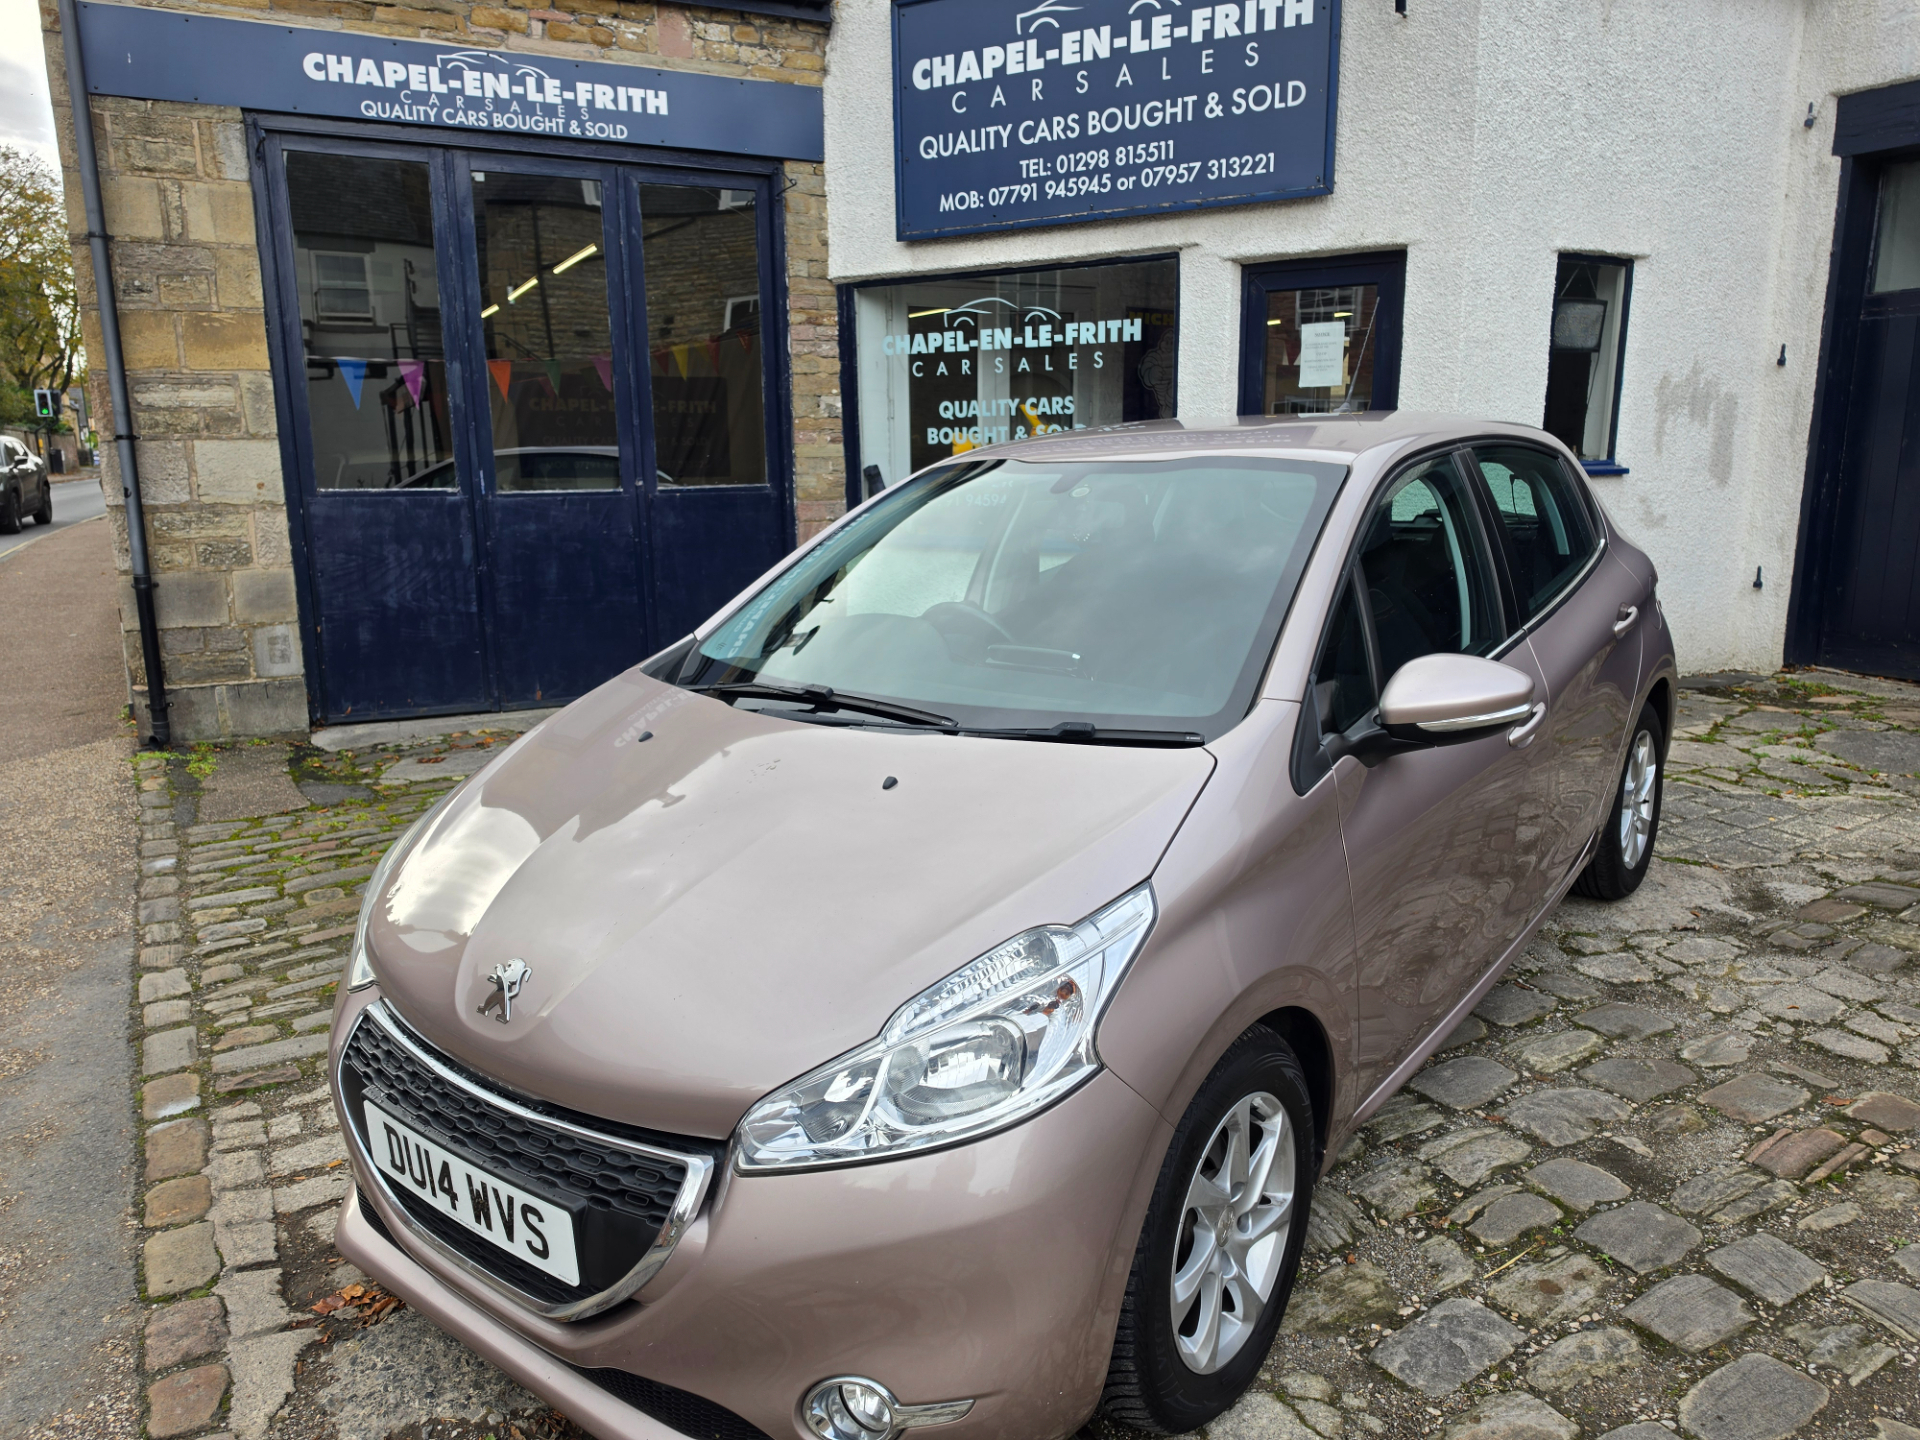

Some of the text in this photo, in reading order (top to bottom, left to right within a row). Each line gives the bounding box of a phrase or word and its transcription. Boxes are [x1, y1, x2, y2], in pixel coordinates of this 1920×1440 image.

[912, 0, 1315, 90] CHAPEL-EN-LE-FRITH
[303, 52, 669, 115] CHAPEL-EN-LE-FRITH
[951, 42, 1260, 114] CAR SALES
[360, 101, 628, 139] QUALITY CARS BOUGHT & SOLD
[400, 90, 589, 120] CAR SALES
[919, 80, 1307, 160] QUALITY CARS BOUGHT & SOLD
[1020, 140, 1174, 179] TEL: 01298 815511
[939, 152, 1275, 212] MOB: 07791 945945 or 07957 313221
[882, 318, 1142, 356] CHAPEL-EN-LE-FRITH
[912, 351, 1104, 377] CAR SALES
[939, 395, 1075, 419] QUALITY CARS
[927, 425, 1009, 445] BOUGHT
[1015, 425, 1029, 440] &
[382, 1120, 550, 1261] DU14 WVS
